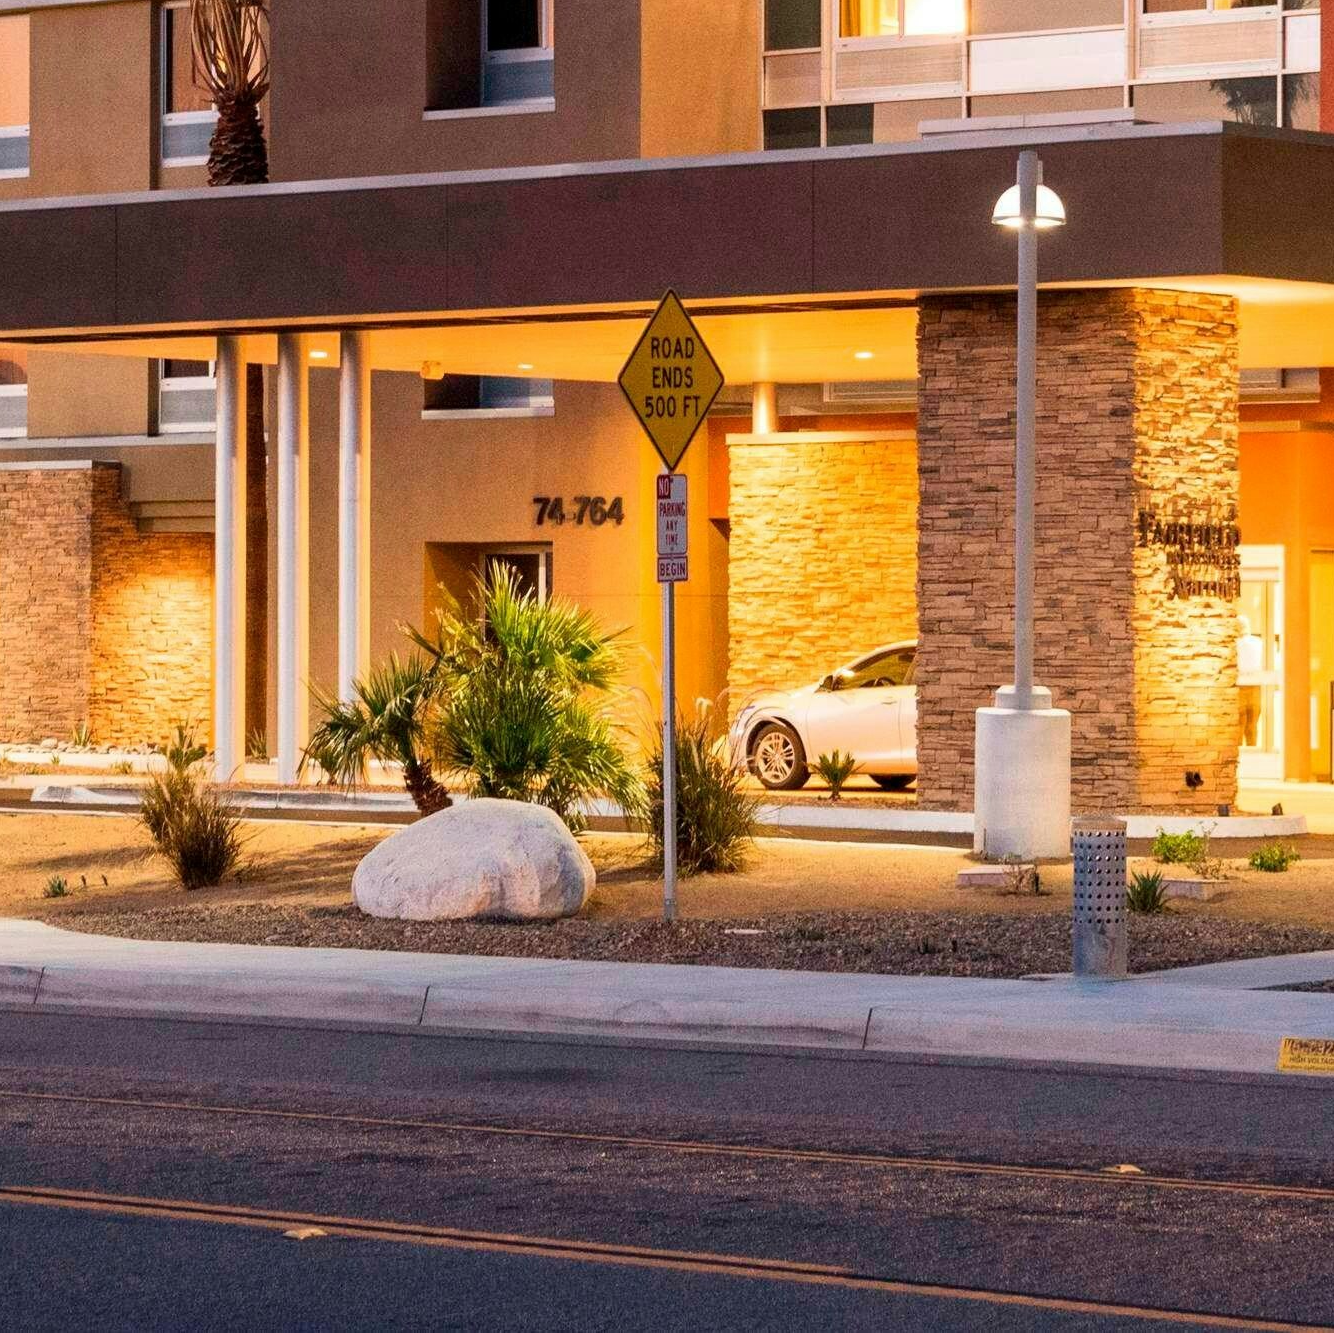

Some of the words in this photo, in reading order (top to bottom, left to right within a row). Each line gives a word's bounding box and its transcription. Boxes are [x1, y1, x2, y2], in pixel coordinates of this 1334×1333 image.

[651, 337, 695, 359] ROAD
[652, 367, 694, 389] ENDS
[644, 396, 676, 417] 500
[683, 396, 701, 417] FT
[659, 477, 670, 497] NO
[659, 502, 685, 517] PARKING
[666, 520, 678, 532] ANY
[665, 533, 678, 546] TIME
[659, 562, 686, 576] BEGIN
